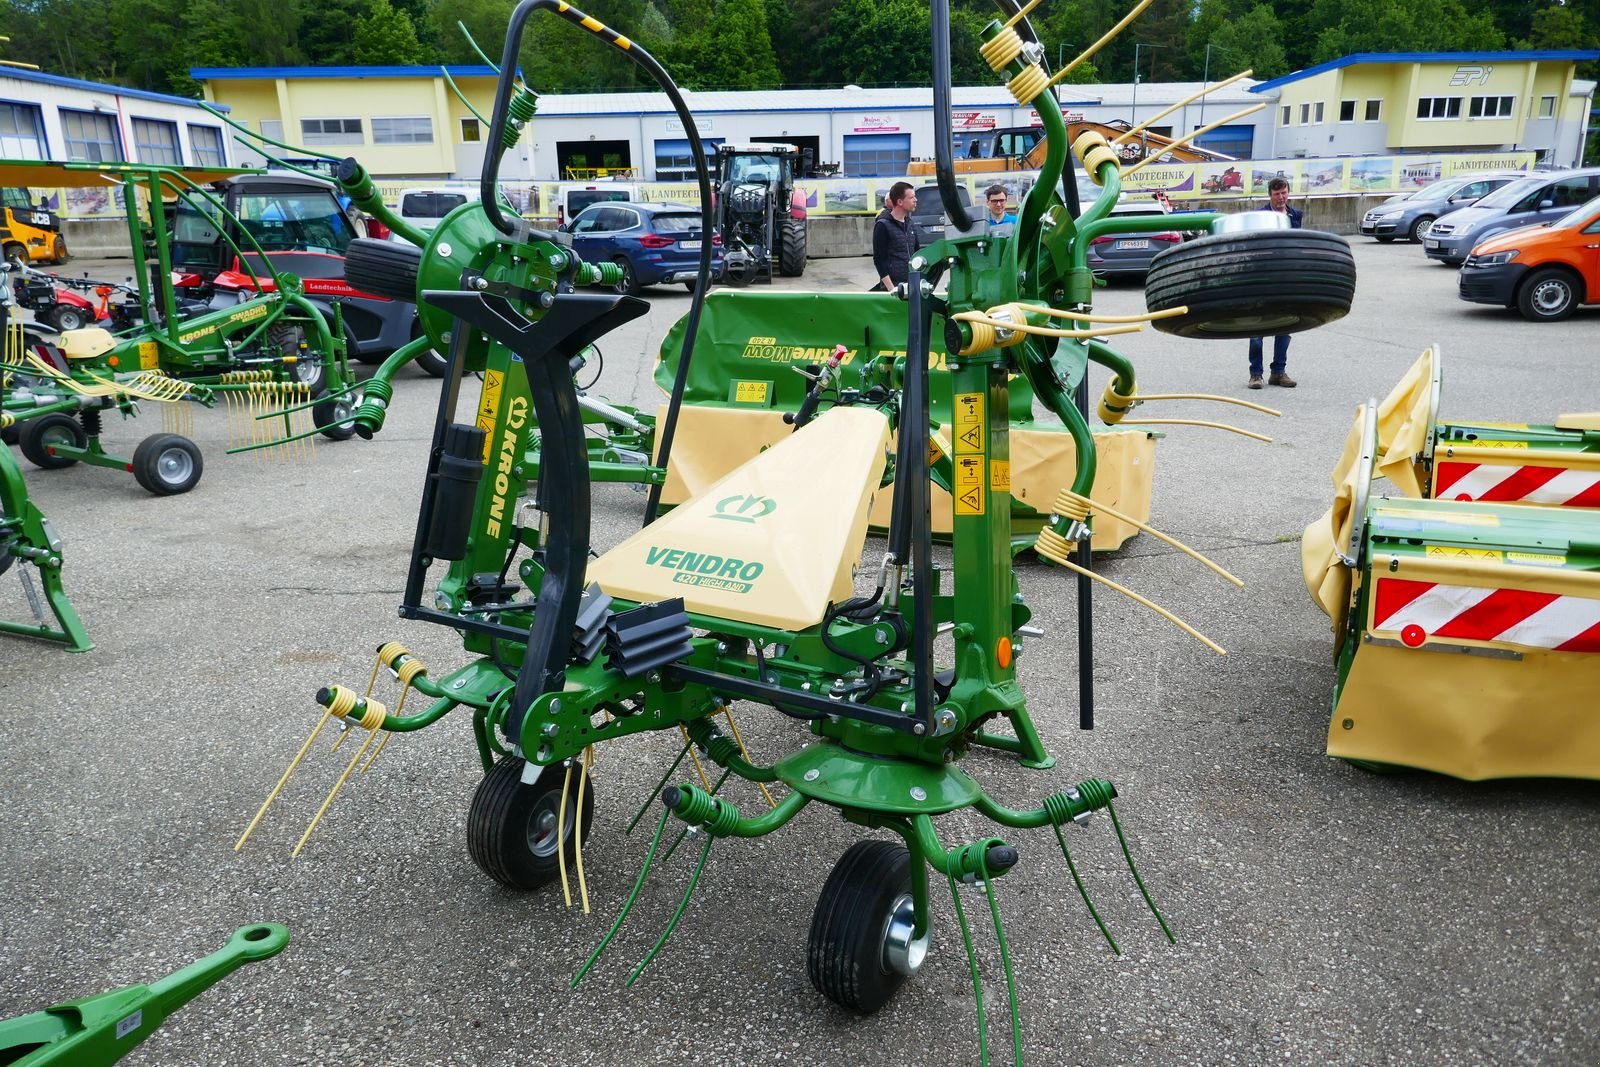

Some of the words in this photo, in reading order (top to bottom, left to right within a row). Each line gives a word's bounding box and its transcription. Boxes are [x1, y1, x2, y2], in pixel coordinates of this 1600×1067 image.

[1453, 160, 1518, 170] LANDTECHNIK
[31, 211, 51, 225] JCB
[230, 304, 267, 321] SWADRO
[179, 325, 215, 345] KRONE
[486, 429, 517, 539] KRONE
[646, 546, 764, 582] VENDRO
[677, 573, 698, 585] 420
[698, 576, 746, 593] HIGHLAND
